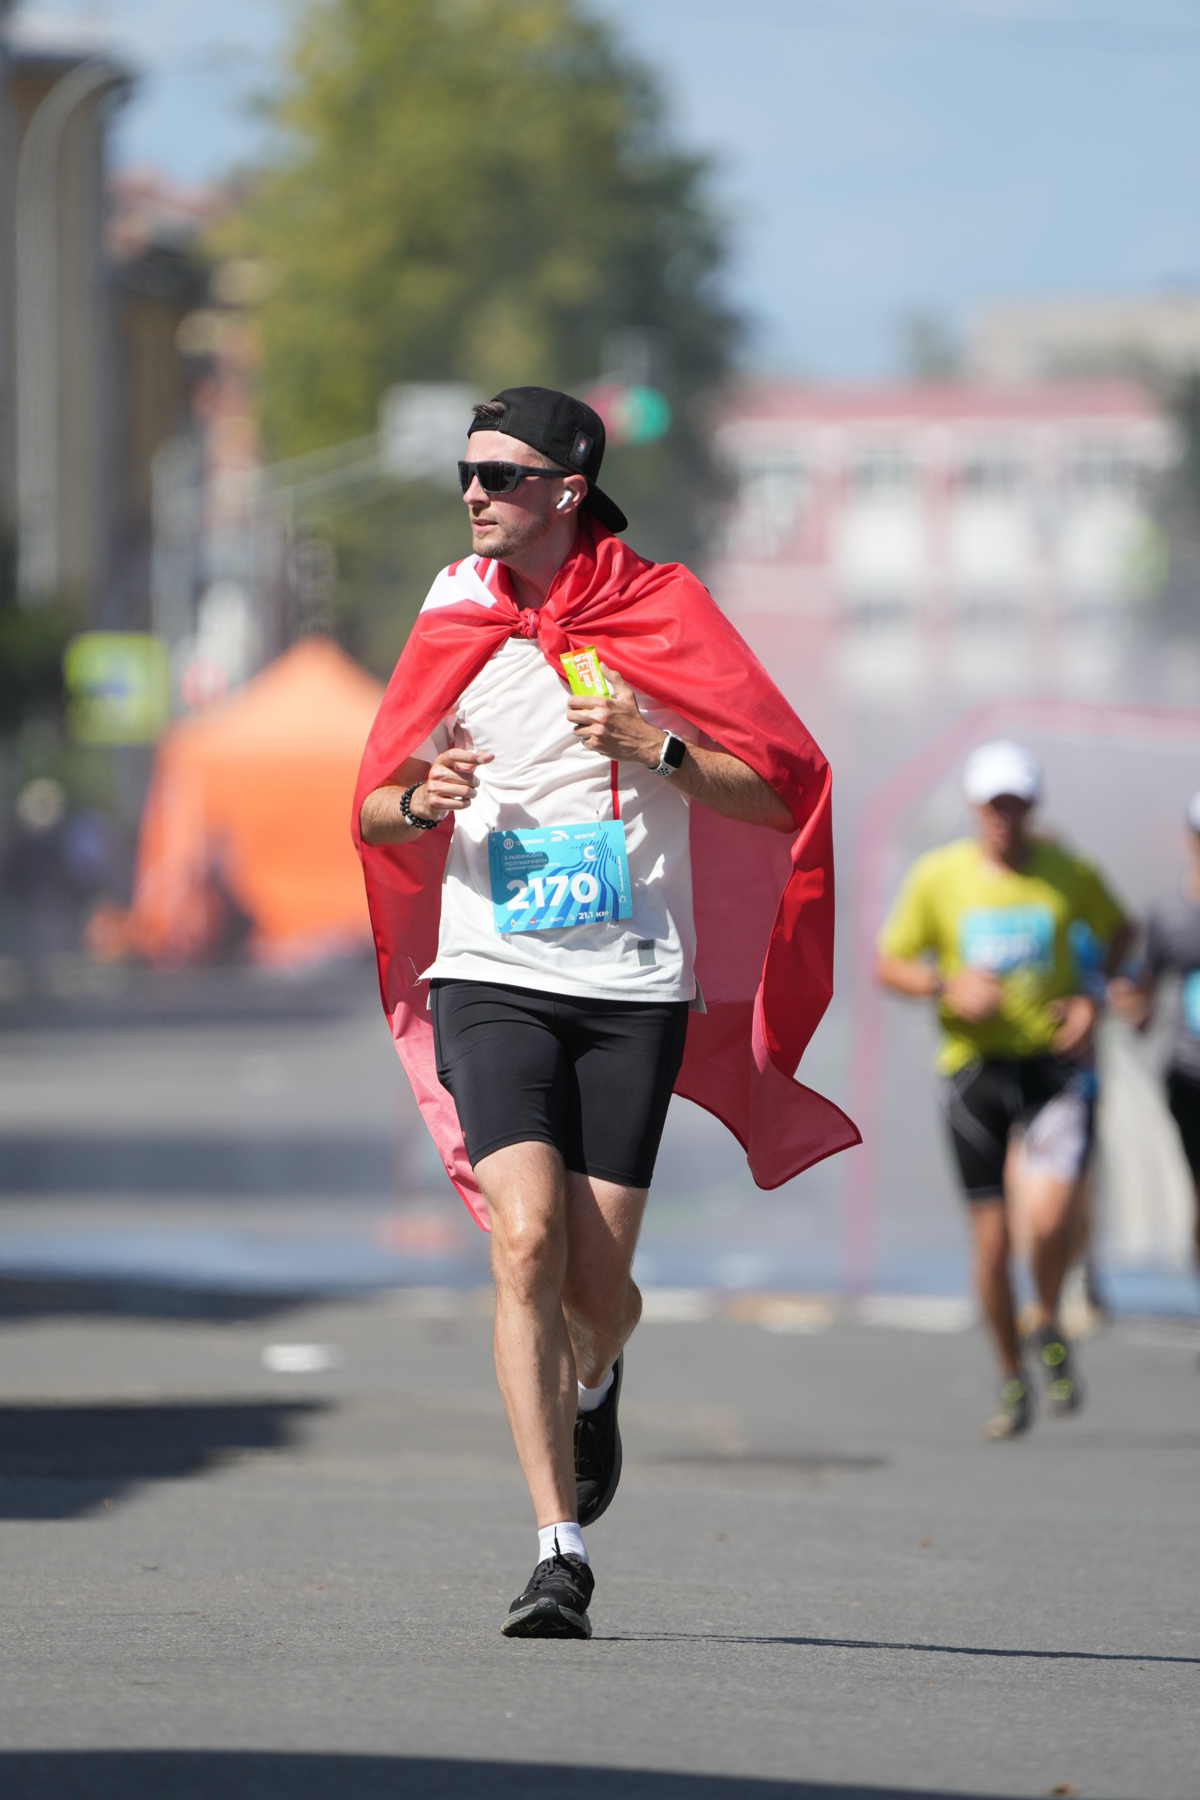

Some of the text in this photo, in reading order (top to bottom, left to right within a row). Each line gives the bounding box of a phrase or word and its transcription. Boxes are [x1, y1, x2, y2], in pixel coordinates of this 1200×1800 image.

[573, 653, 590, 678] GEL
[508, 851, 543, 860] РЫБИНСКИЙ
[504, 858, 548, 867] ПОЛУМАРАФОН
[506, 872, 599, 910] 2170
[578, 911, 594, 920] 21.1
